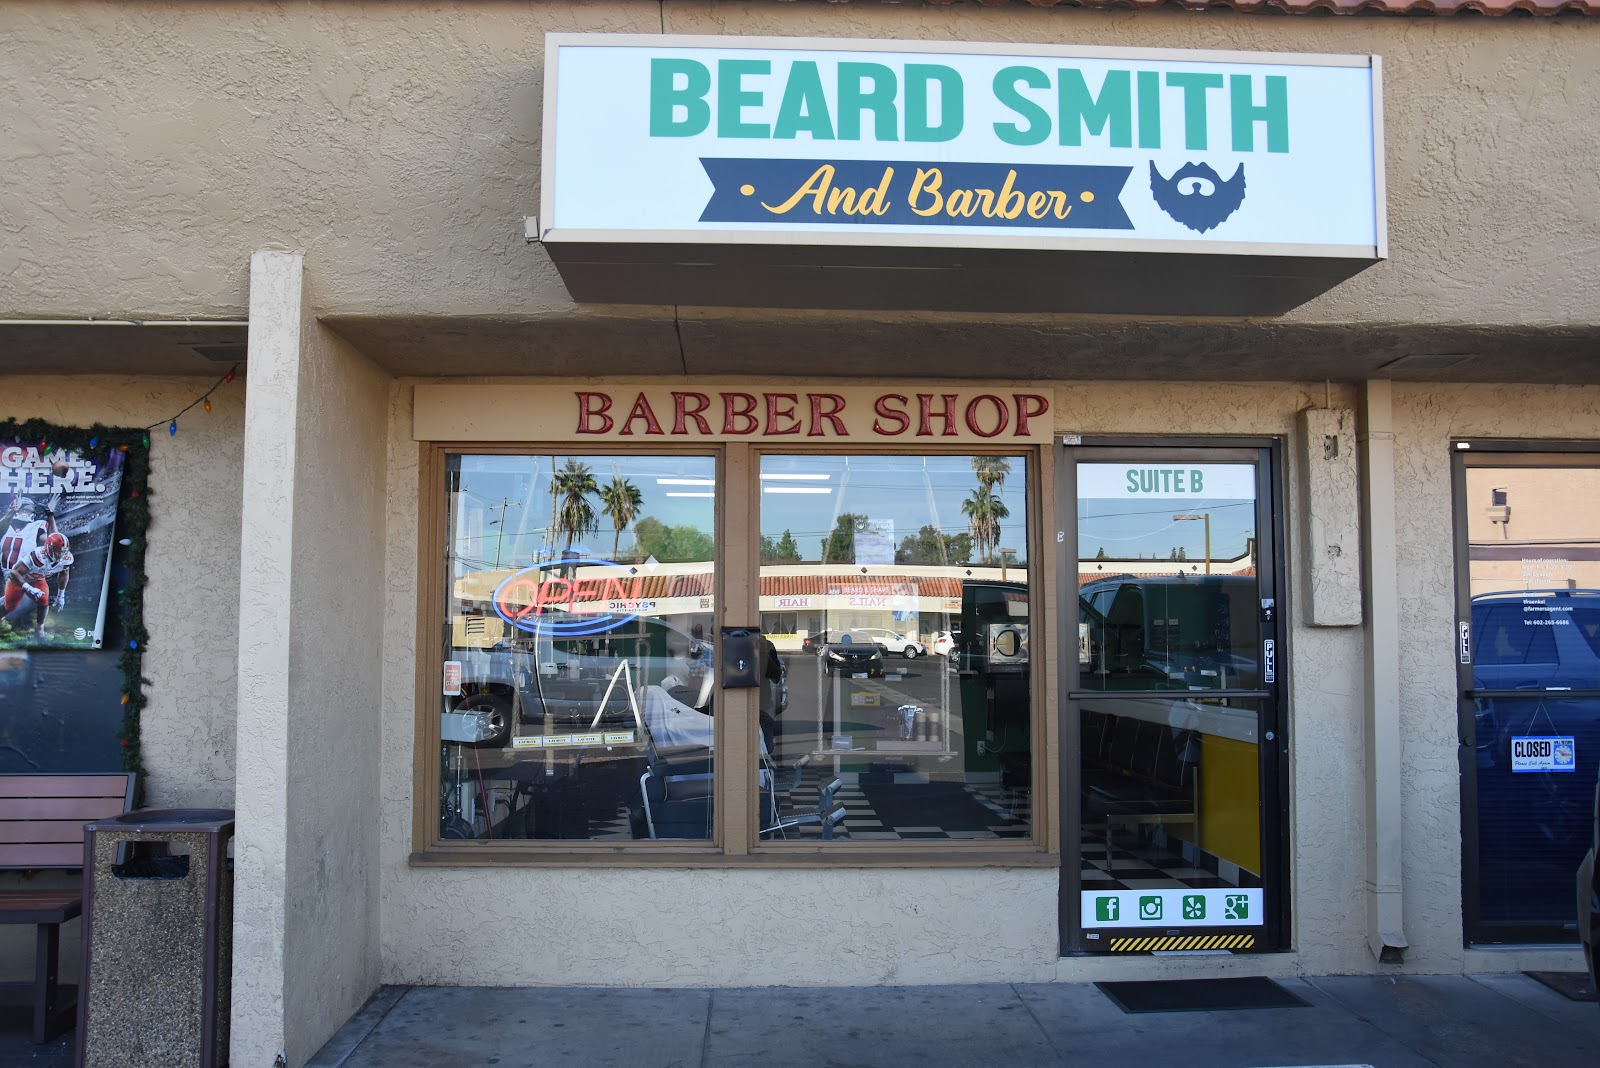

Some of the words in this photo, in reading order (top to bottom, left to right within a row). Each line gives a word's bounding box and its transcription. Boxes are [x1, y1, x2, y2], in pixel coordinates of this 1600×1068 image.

[649, 58, 964, 143] BEARD
[992, 65, 1290, 154] SMITH
[761, 164, 894, 216] And
[907, 167, 1072, 220] Barber
[574, 391, 850, 437] BARBER
[872, 393, 1050, 438] SHOP
[1, 446, 92, 468] GAME.
[0, 465, 106, 493] HERE.
[1126, 469, 1185, 493] SUITE
[1190, 470, 1204, 493] B
[499, 577, 640, 618] OPEN
[1514, 741, 1551, 758] CLOSED
